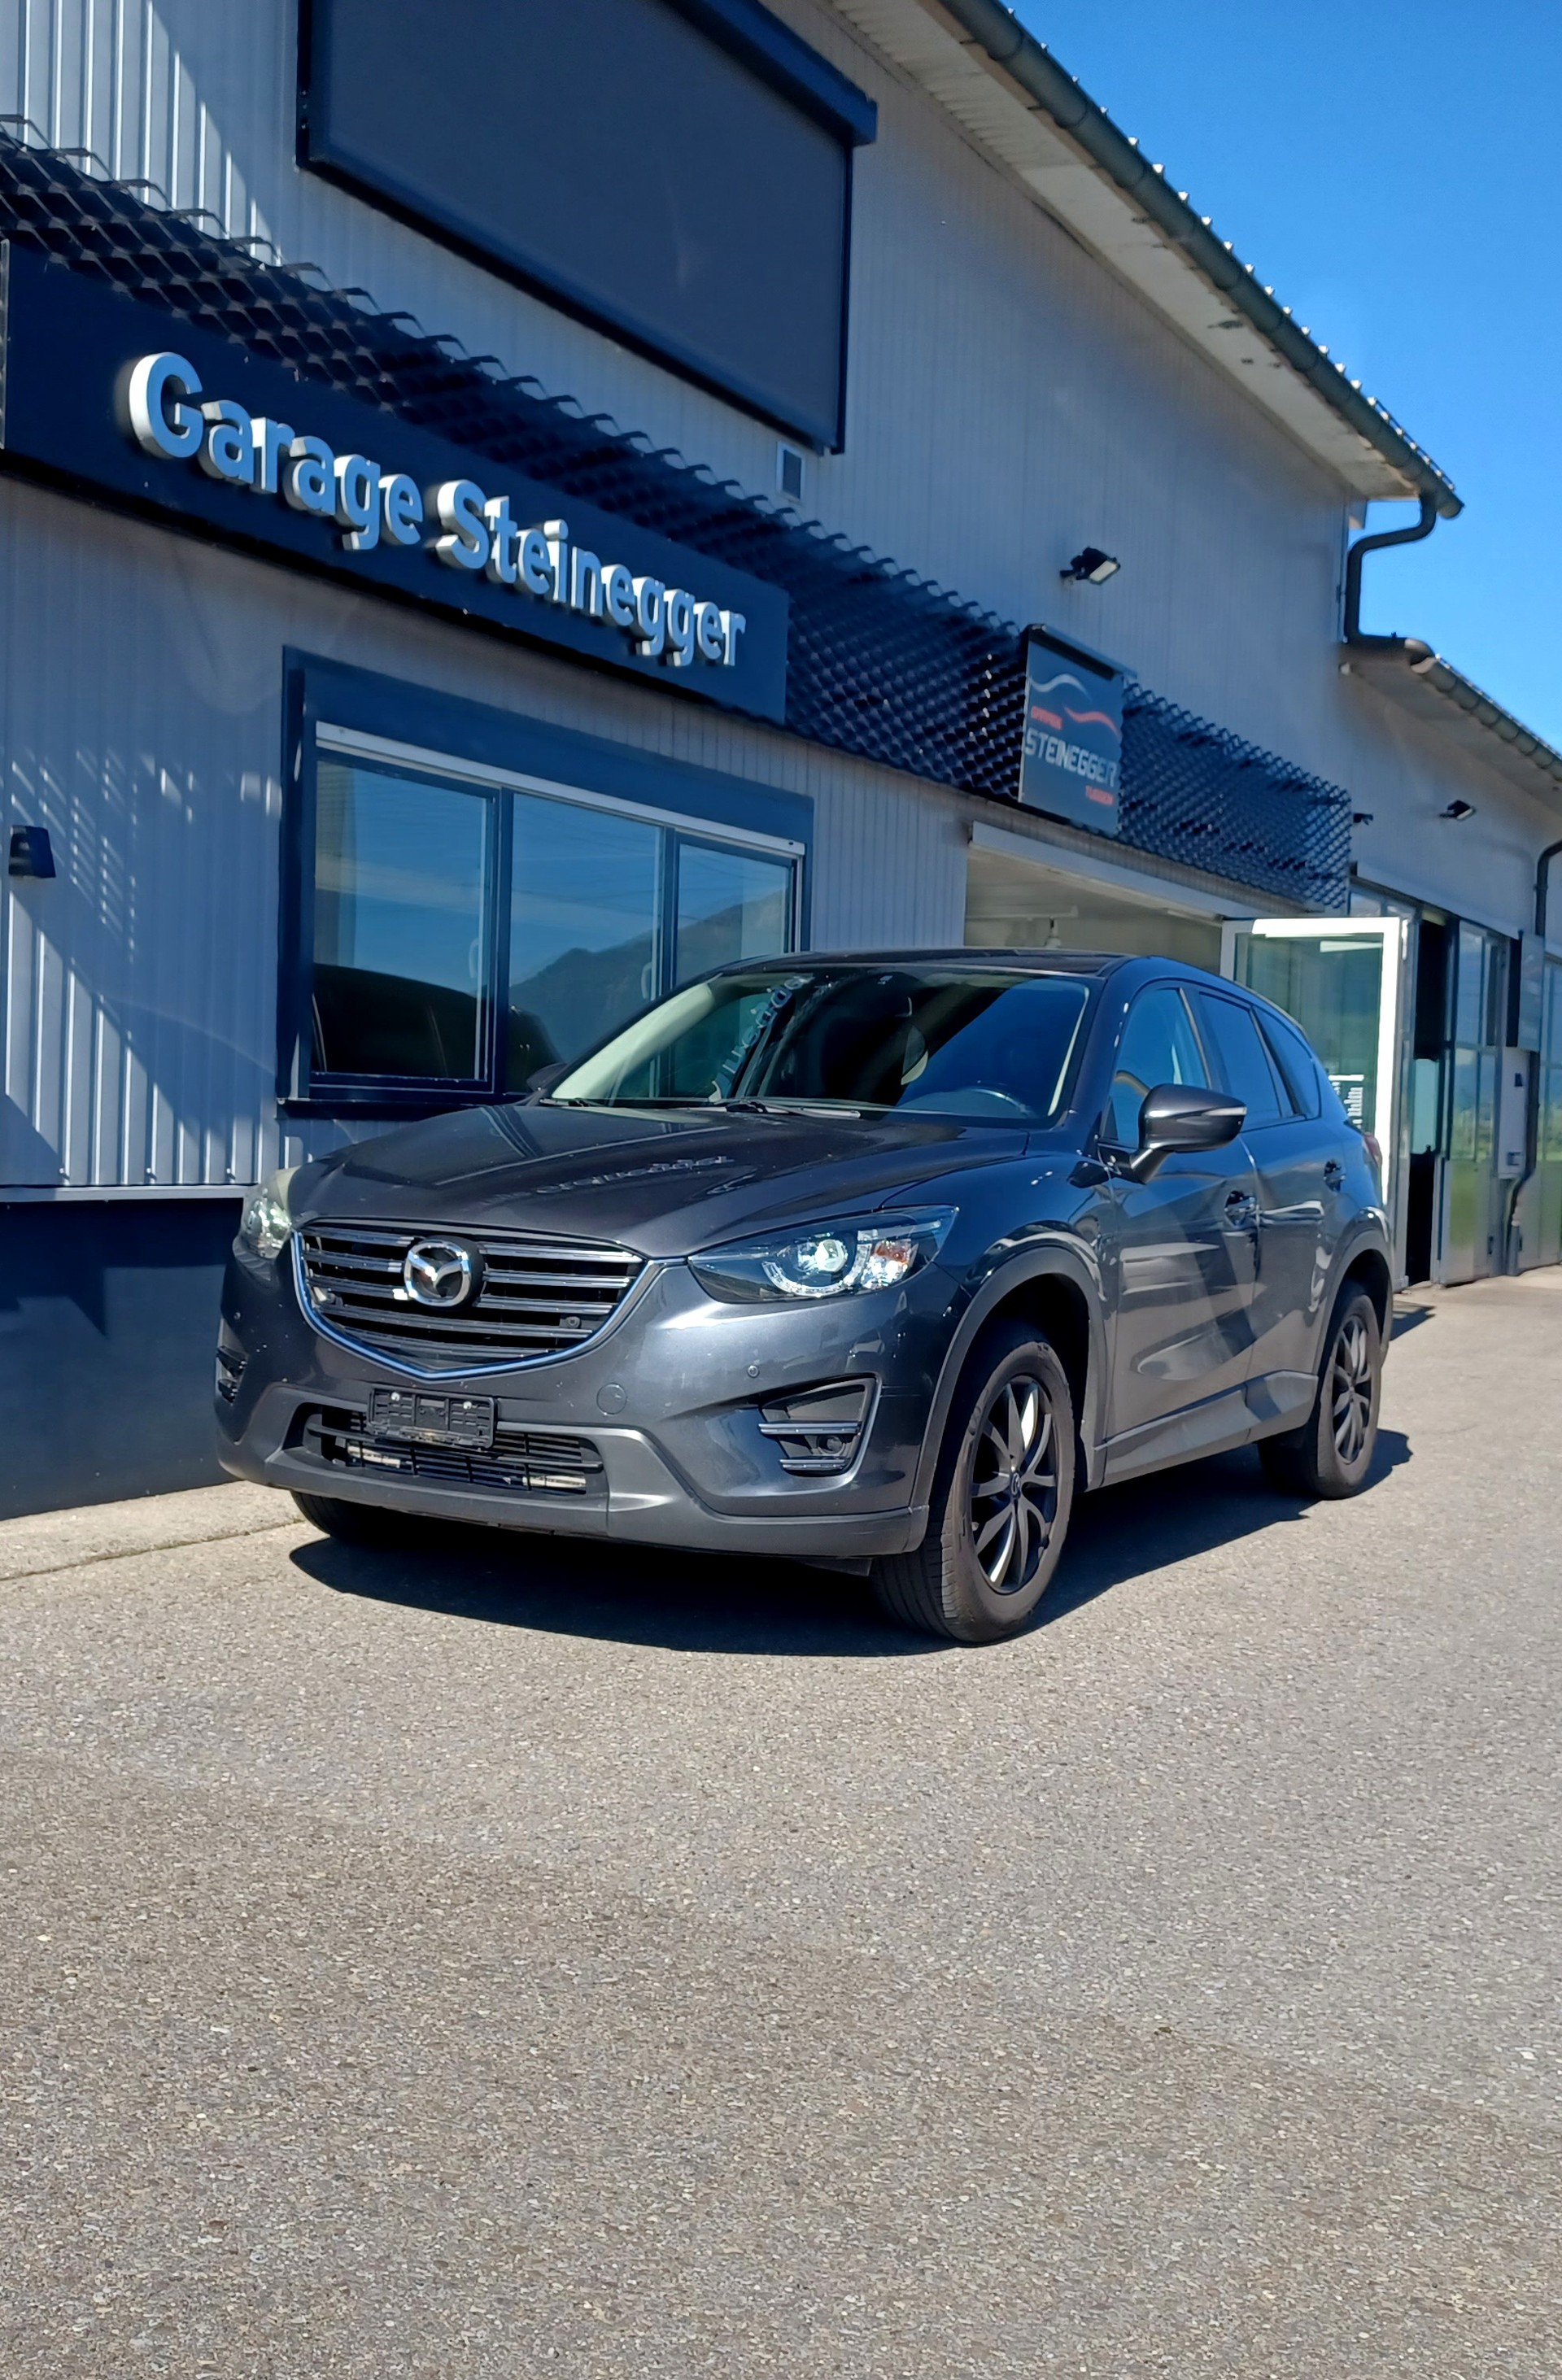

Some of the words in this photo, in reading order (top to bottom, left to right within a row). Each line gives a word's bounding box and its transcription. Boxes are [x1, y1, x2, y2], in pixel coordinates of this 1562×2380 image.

[128, 351, 424, 551] Garage
[434, 478, 747, 668] Steinegger
[1024, 726, 1118, 788] STEINEGGER
